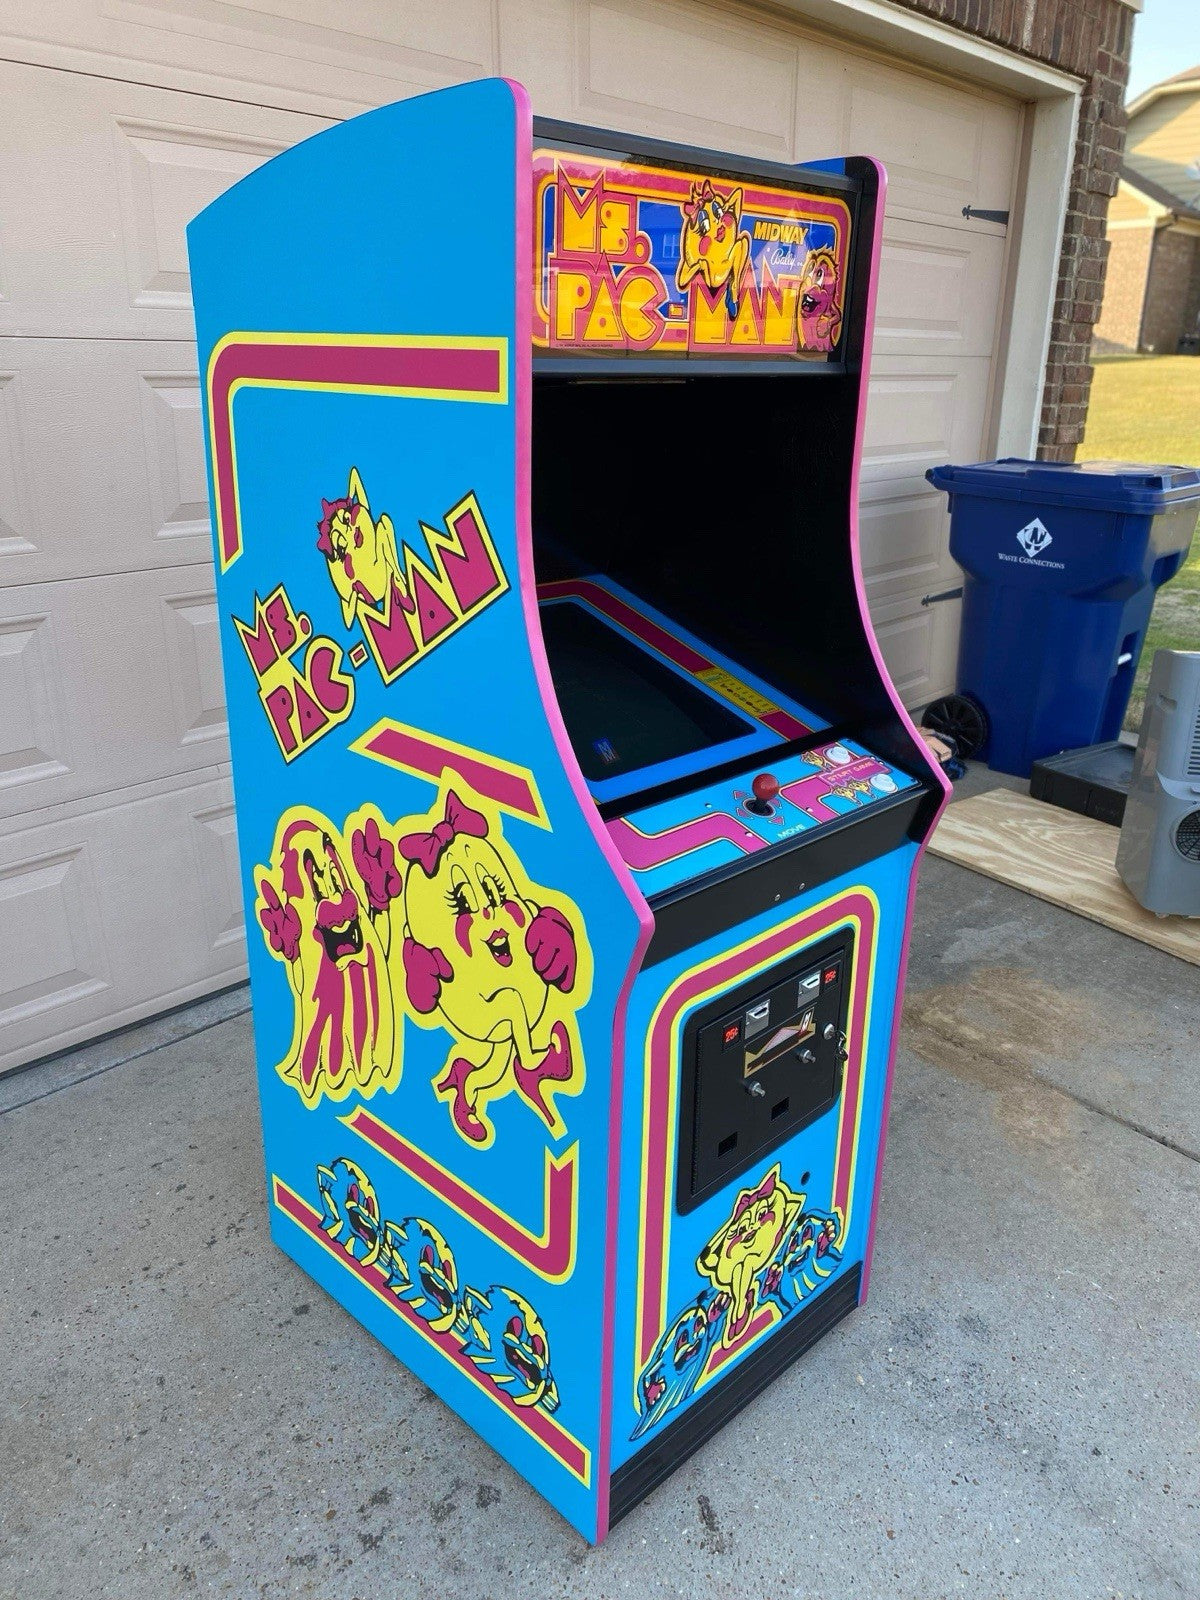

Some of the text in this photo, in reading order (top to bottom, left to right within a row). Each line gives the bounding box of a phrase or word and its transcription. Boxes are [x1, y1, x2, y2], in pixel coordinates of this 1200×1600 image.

[753, 221, 809, 245] MIDWAY
[770, 247, 796, 271] Bally
[553, 256, 798, 345] PAC-MAN
[258, 490, 511, 764] PAC-MAN
[777, 824, 805, 838] MOVE
